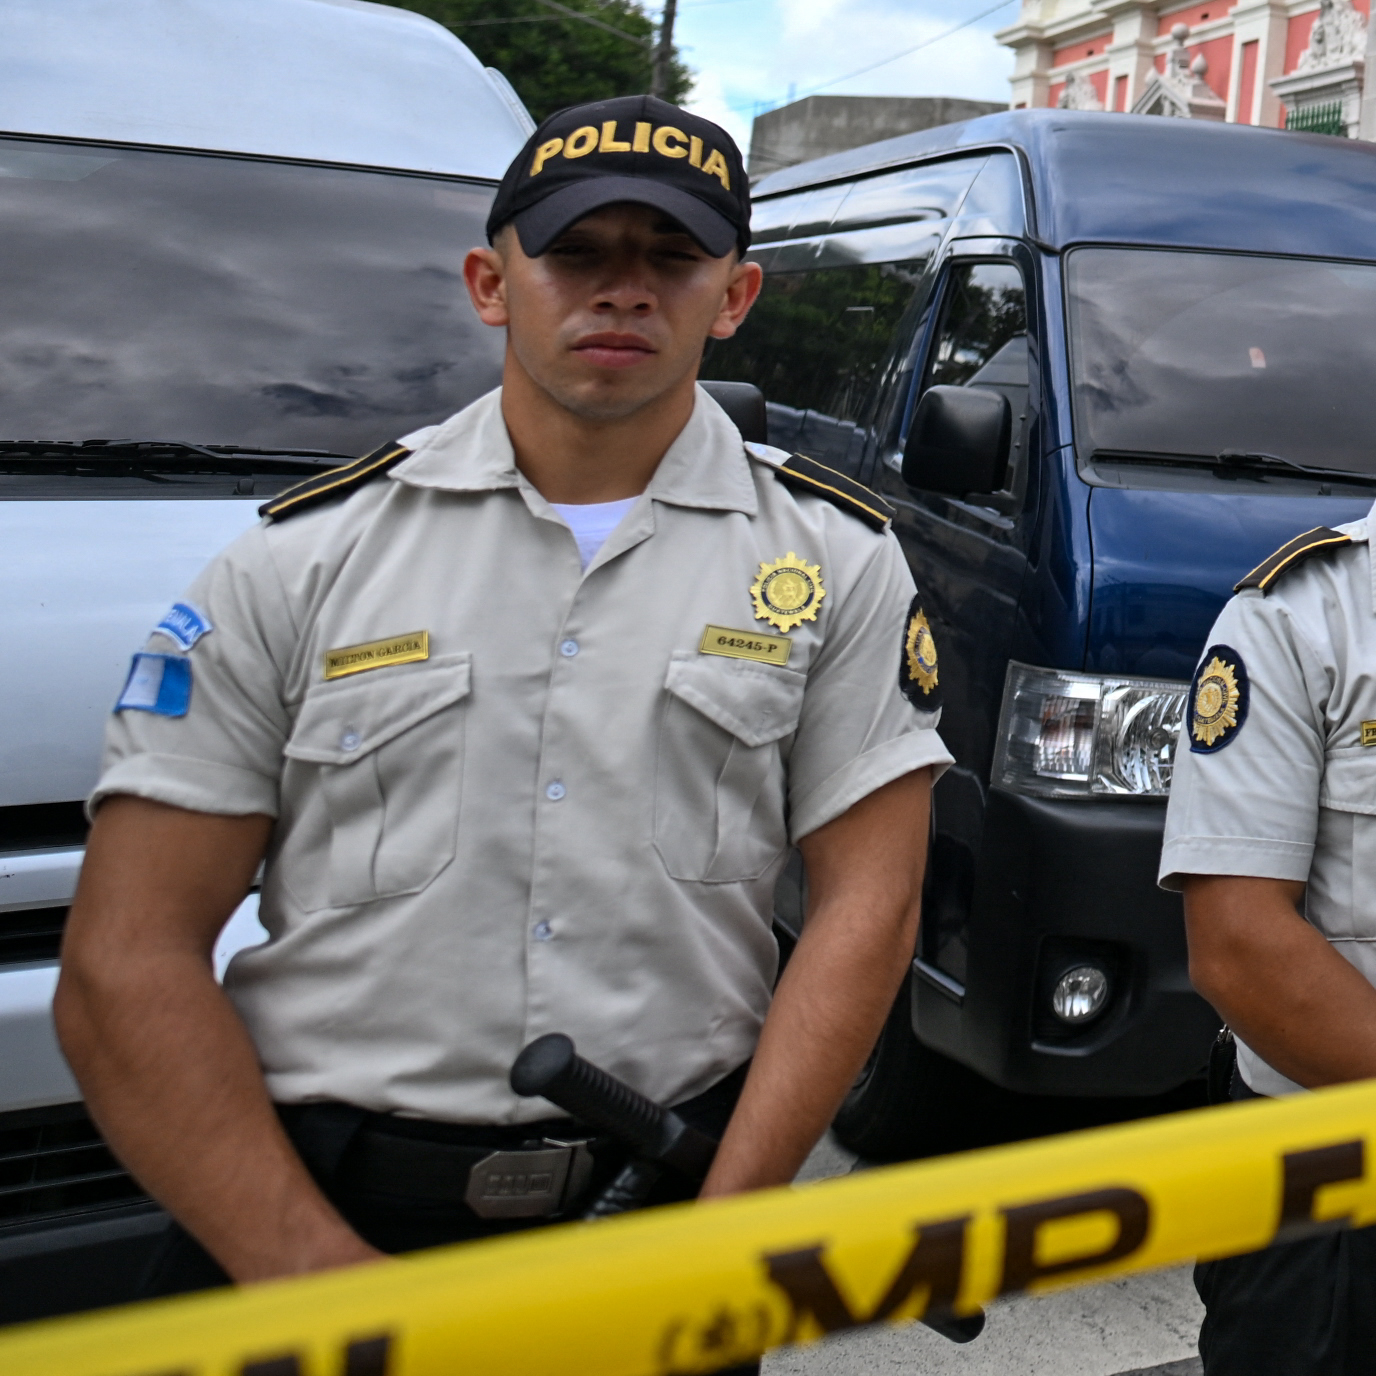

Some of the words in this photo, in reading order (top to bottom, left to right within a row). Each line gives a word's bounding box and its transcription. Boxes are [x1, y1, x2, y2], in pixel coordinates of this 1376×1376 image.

[529, 120, 731, 191] POLICIA
[329, 650, 376, 668] MILTON
[379, 641, 422, 658] GARCIA
[717, 635, 778, 653] 64245-P
